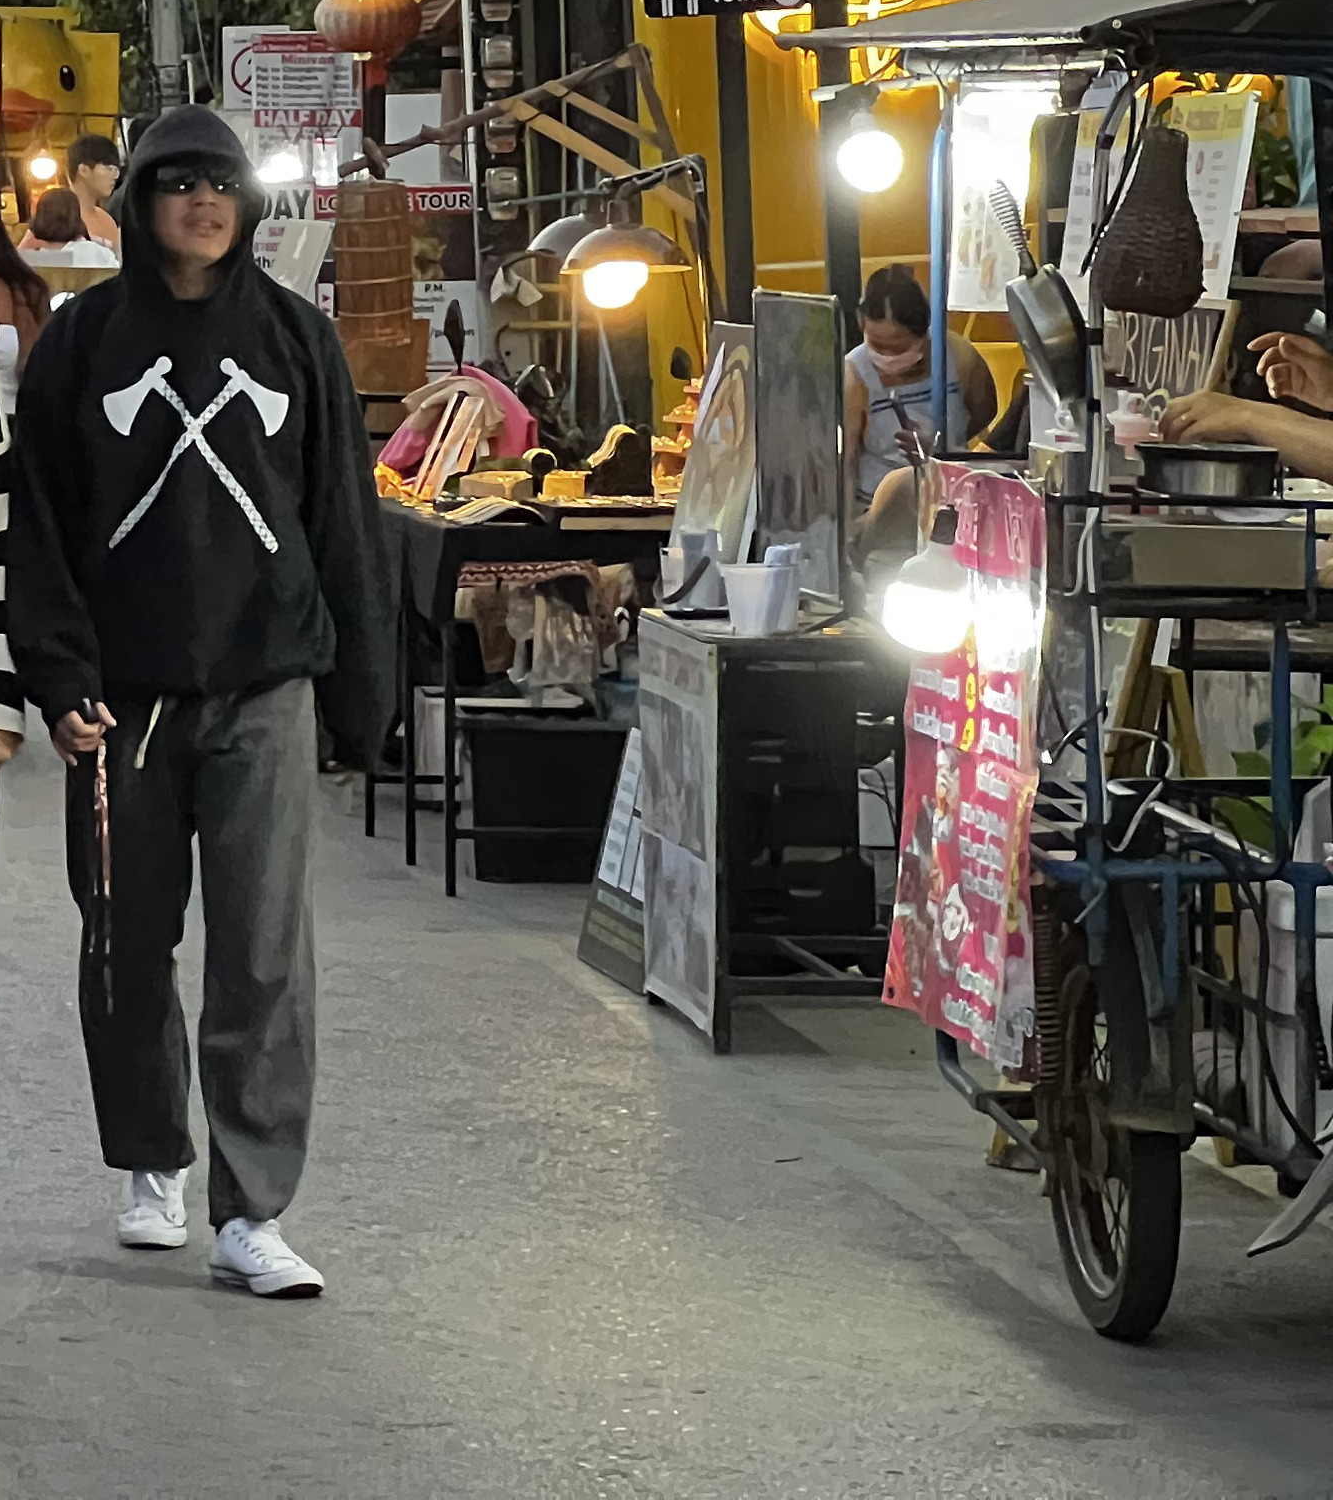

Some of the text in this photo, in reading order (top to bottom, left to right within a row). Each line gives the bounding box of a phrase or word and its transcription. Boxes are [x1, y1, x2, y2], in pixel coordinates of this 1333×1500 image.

[259, 109, 355, 127] HALF DAY
[418, 193, 471, 211] TOUR
